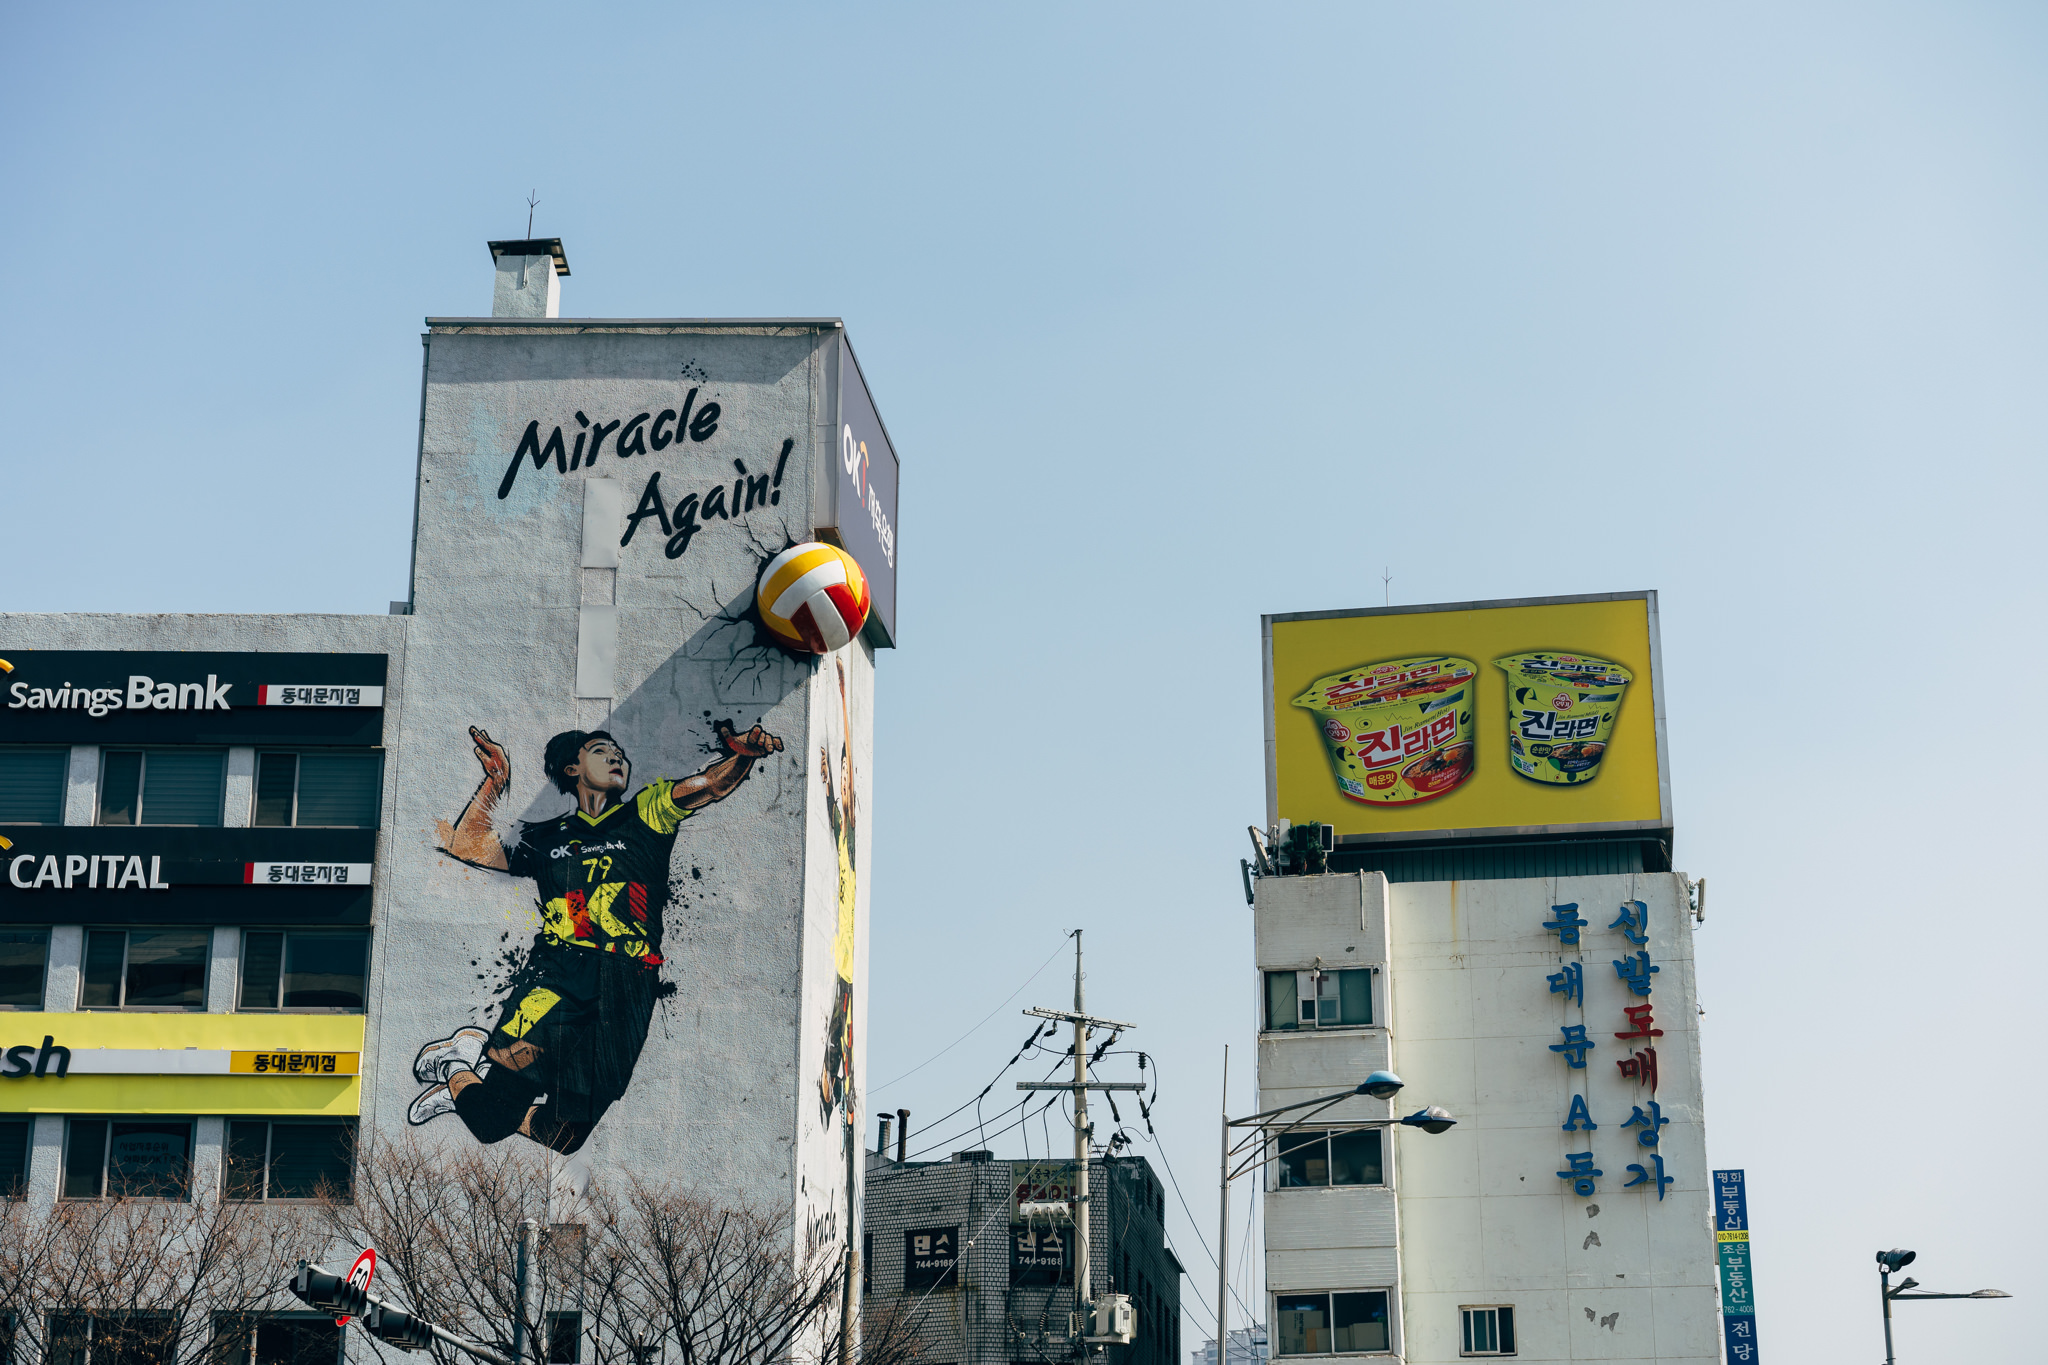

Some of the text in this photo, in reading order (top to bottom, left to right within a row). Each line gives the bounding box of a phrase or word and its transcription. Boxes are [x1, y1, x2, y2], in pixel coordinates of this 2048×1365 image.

[498, 388, 721, 499] Miracle
[620, 439, 794, 559] Again!
[281, 688, 361, 705] 동대문지점
[1519, 708, 1600, 740] 진라면
[1355, 708, 1457, 770] 진라면
[1368, 772, 1395, 786] 매운맛
[9, 855, 169, 889] CAPITAL
[268, 866, 348, 882] 동대문지점
[582, 855, 613, 883] 79
[0, 1034, 71, 1078] sh
[254, 1054, 336, 1072] 동대문지점
[1716, 1172, 1741, 1183] 평화
[1722, 1185, 1742, 1230] 부동산
[914, 1234, 950, 1255] 댄스
[1722, 1243, 1748, 1254] 조은
[1018, 1256, 1063, 1266] 744-9168
[1726, 1257, 1748, 1303] 부동산
